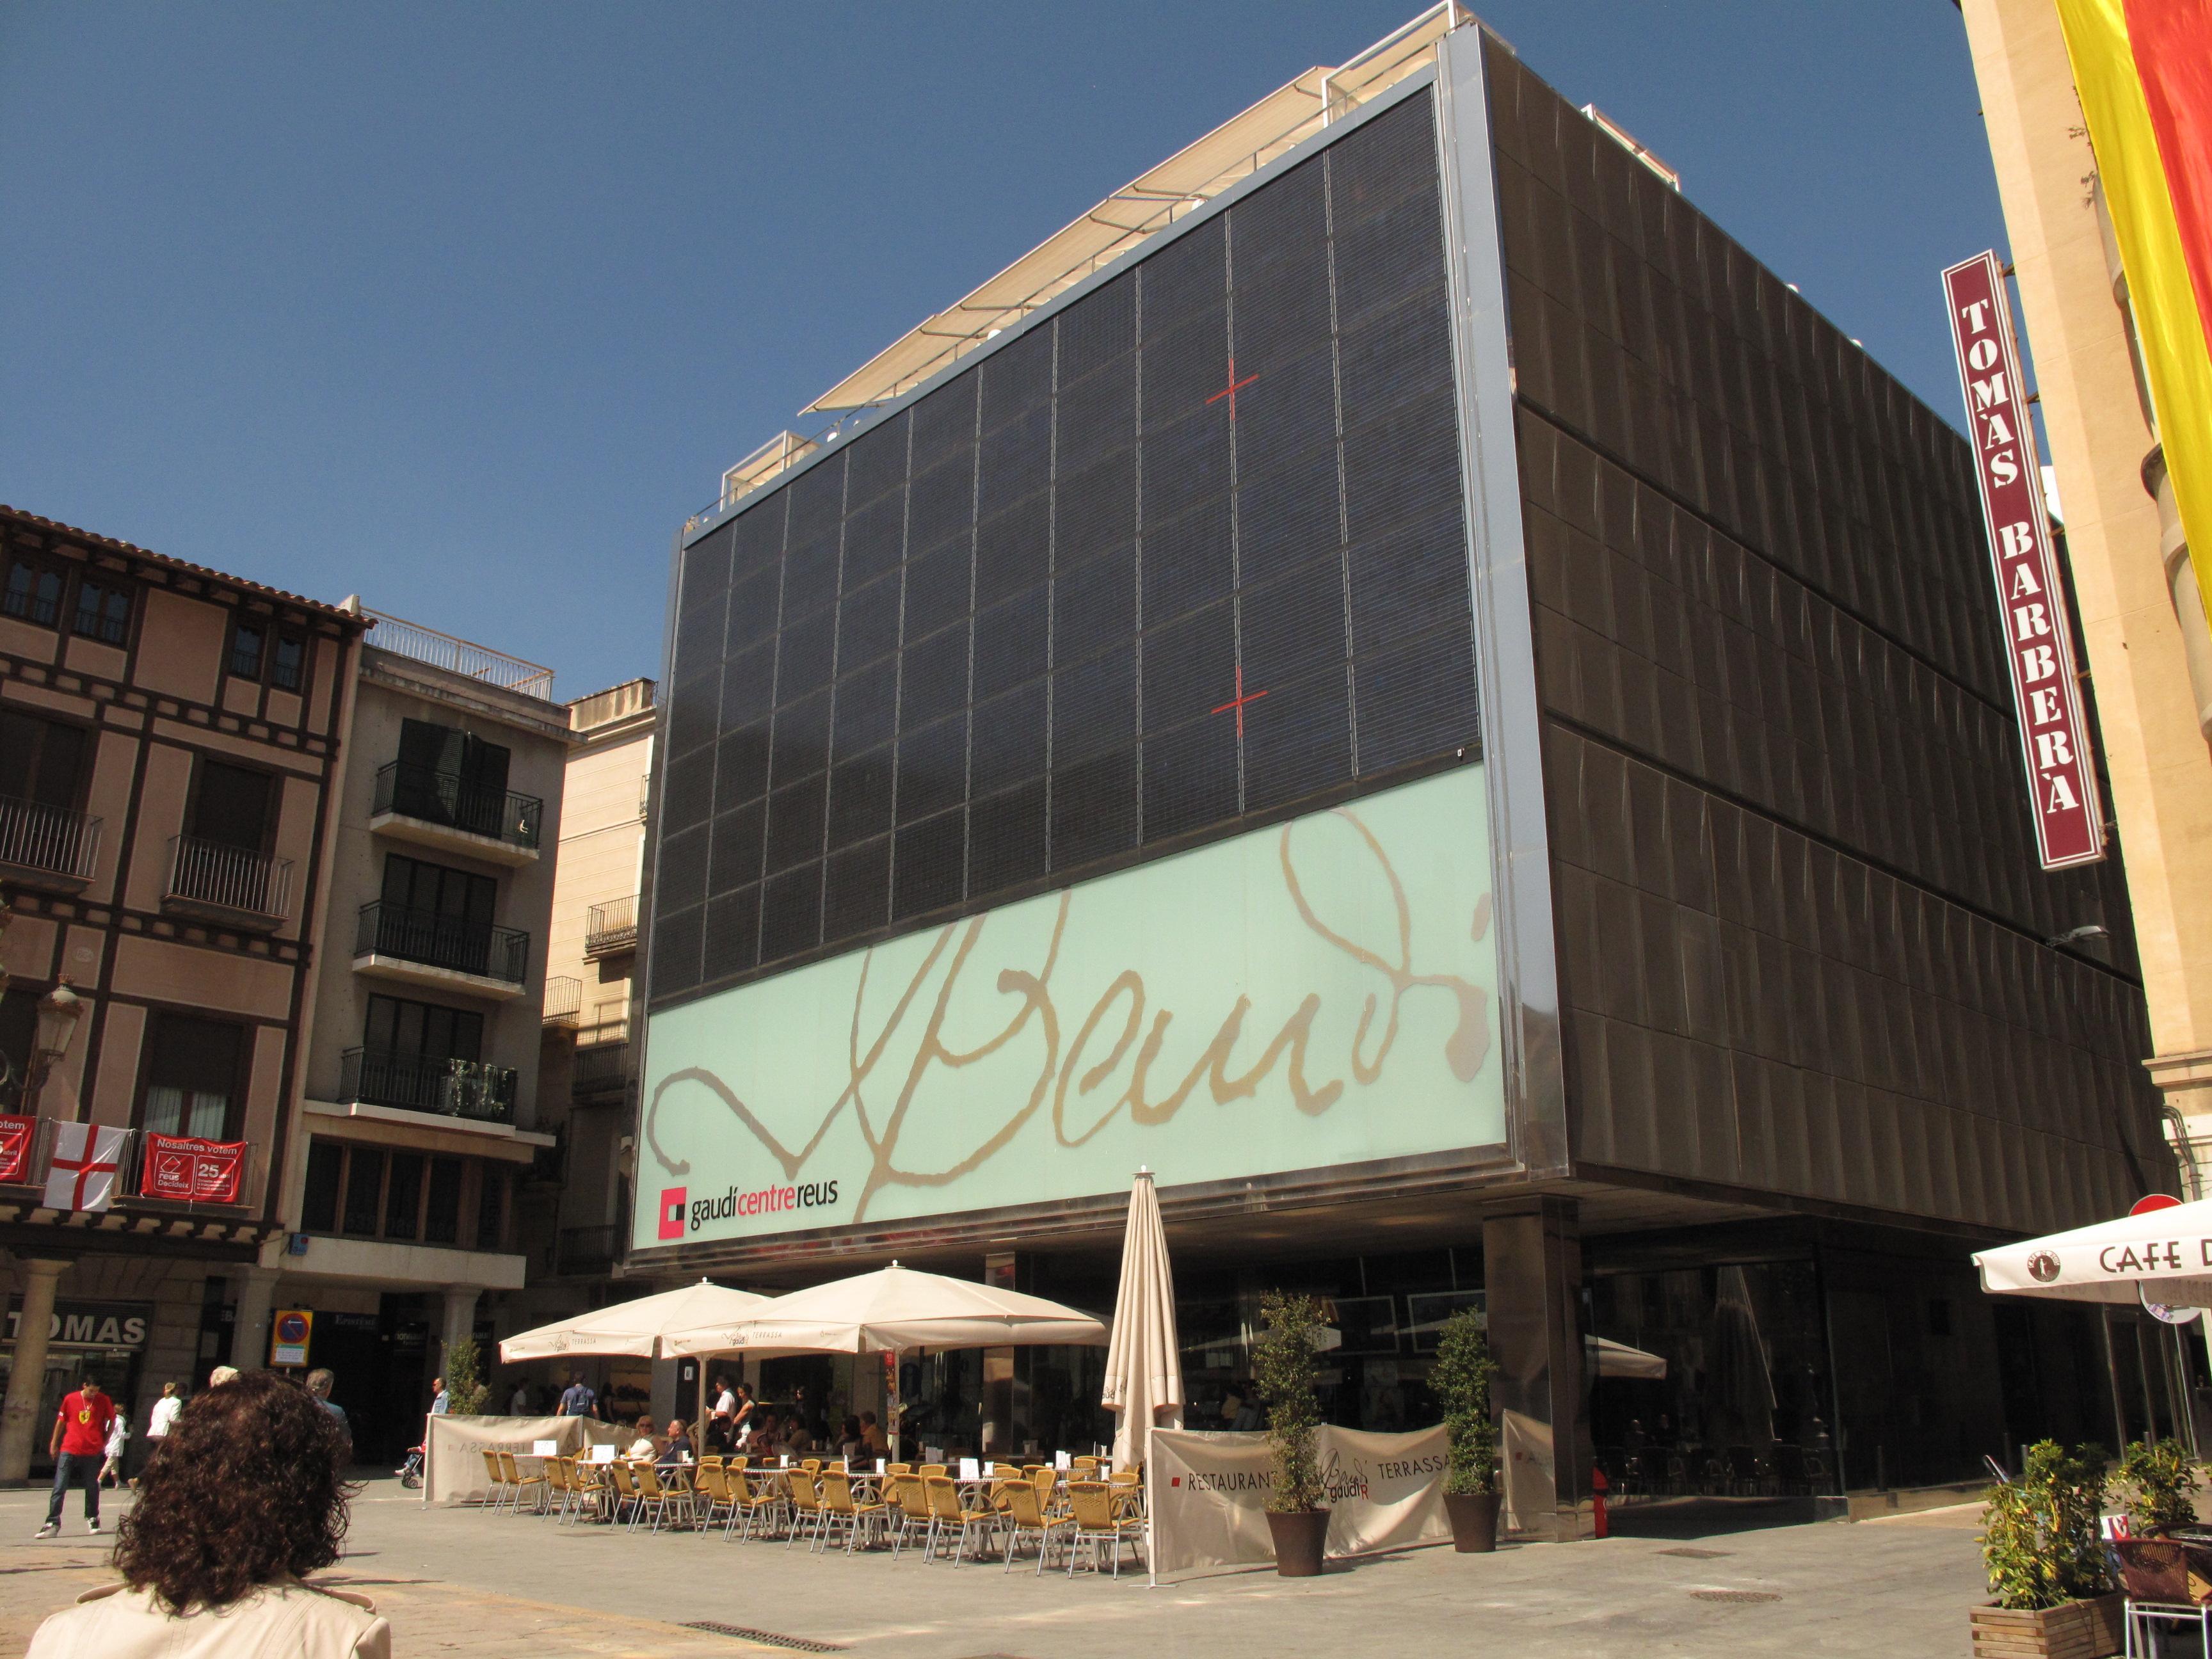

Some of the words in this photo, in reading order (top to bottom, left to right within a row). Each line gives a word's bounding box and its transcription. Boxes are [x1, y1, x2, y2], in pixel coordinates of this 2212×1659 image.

[1961, 298, 2019, 488] TOMÀS
[1999, 520, 2080, 813] BARBERÀ
[157, 1139, 205, 1151] Nosaltres
[207, 1146, 237, 1155] votem
[198, 1163, 220, 1178] 25
[157, 1180, 189, 1189] Decideix
[2099, 1241, 2182, 1273] CAFE
